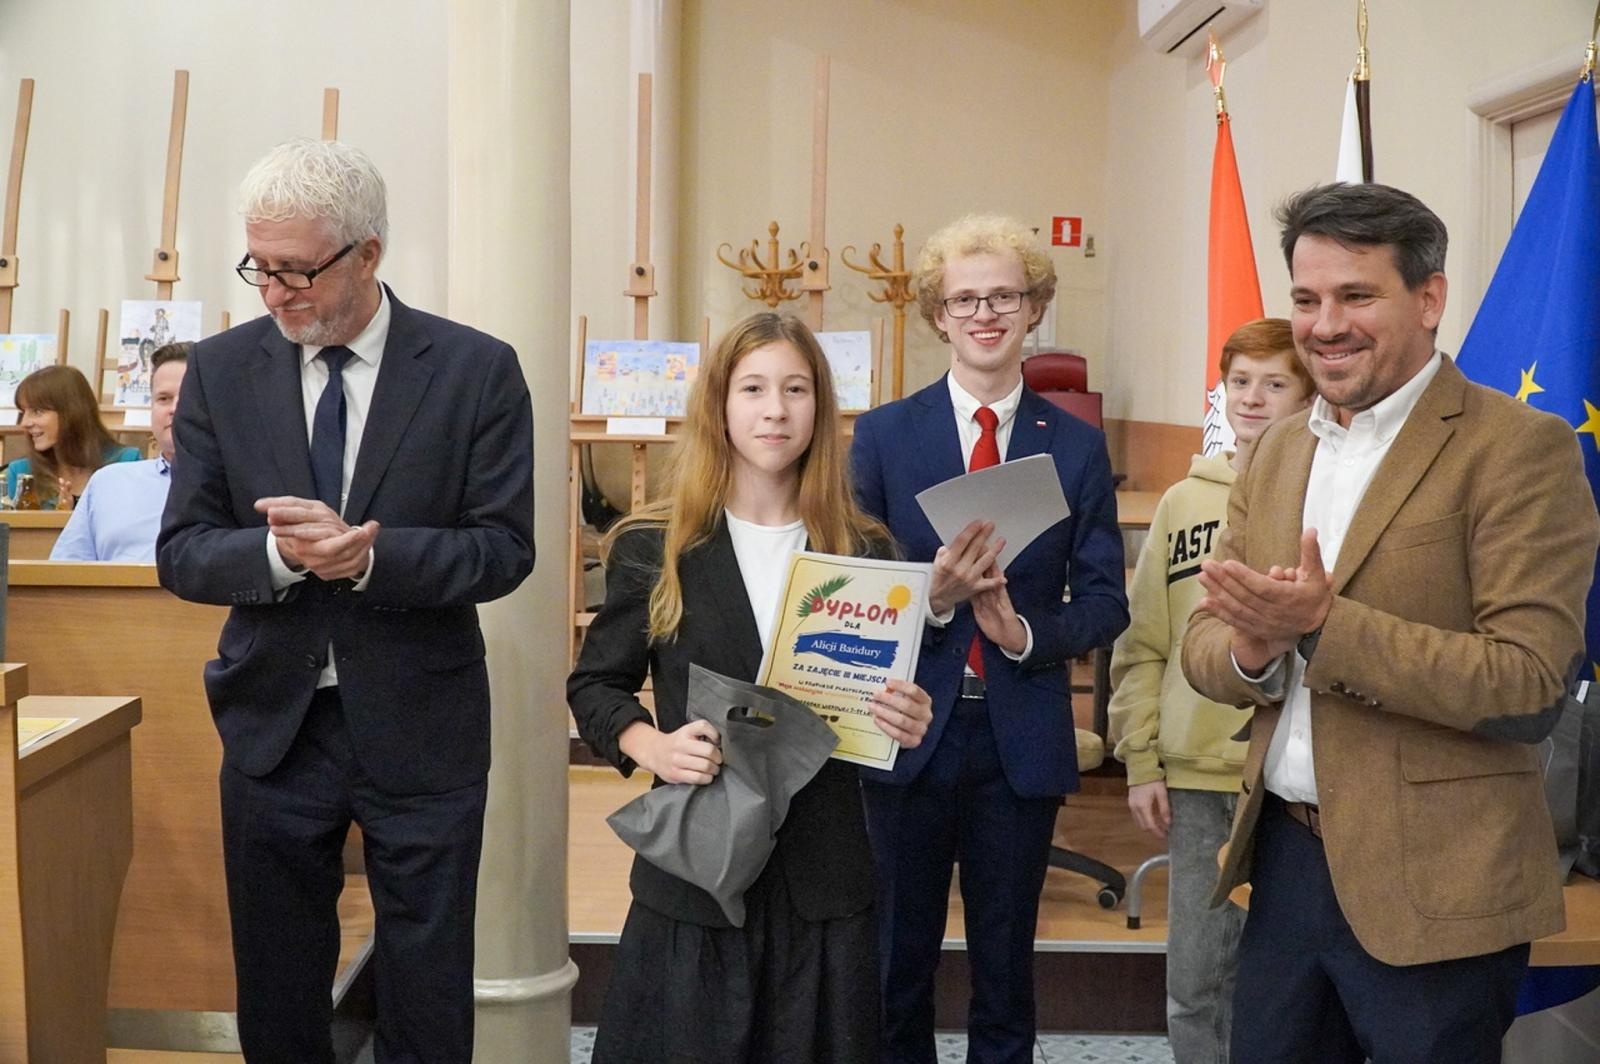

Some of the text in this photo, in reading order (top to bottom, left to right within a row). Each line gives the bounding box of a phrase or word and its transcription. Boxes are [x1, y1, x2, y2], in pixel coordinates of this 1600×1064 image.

[810, 596, 898, 625] DYPLOM
[844, 621, 861, 630] DLA
[811, 640, 882, 658] Alicji Bańdury
[792, 663, 804, 671] ZA
[807, 664, 841, 677] ZAJĘCIE
[852, 672, 888, 684] MIEJSCA
